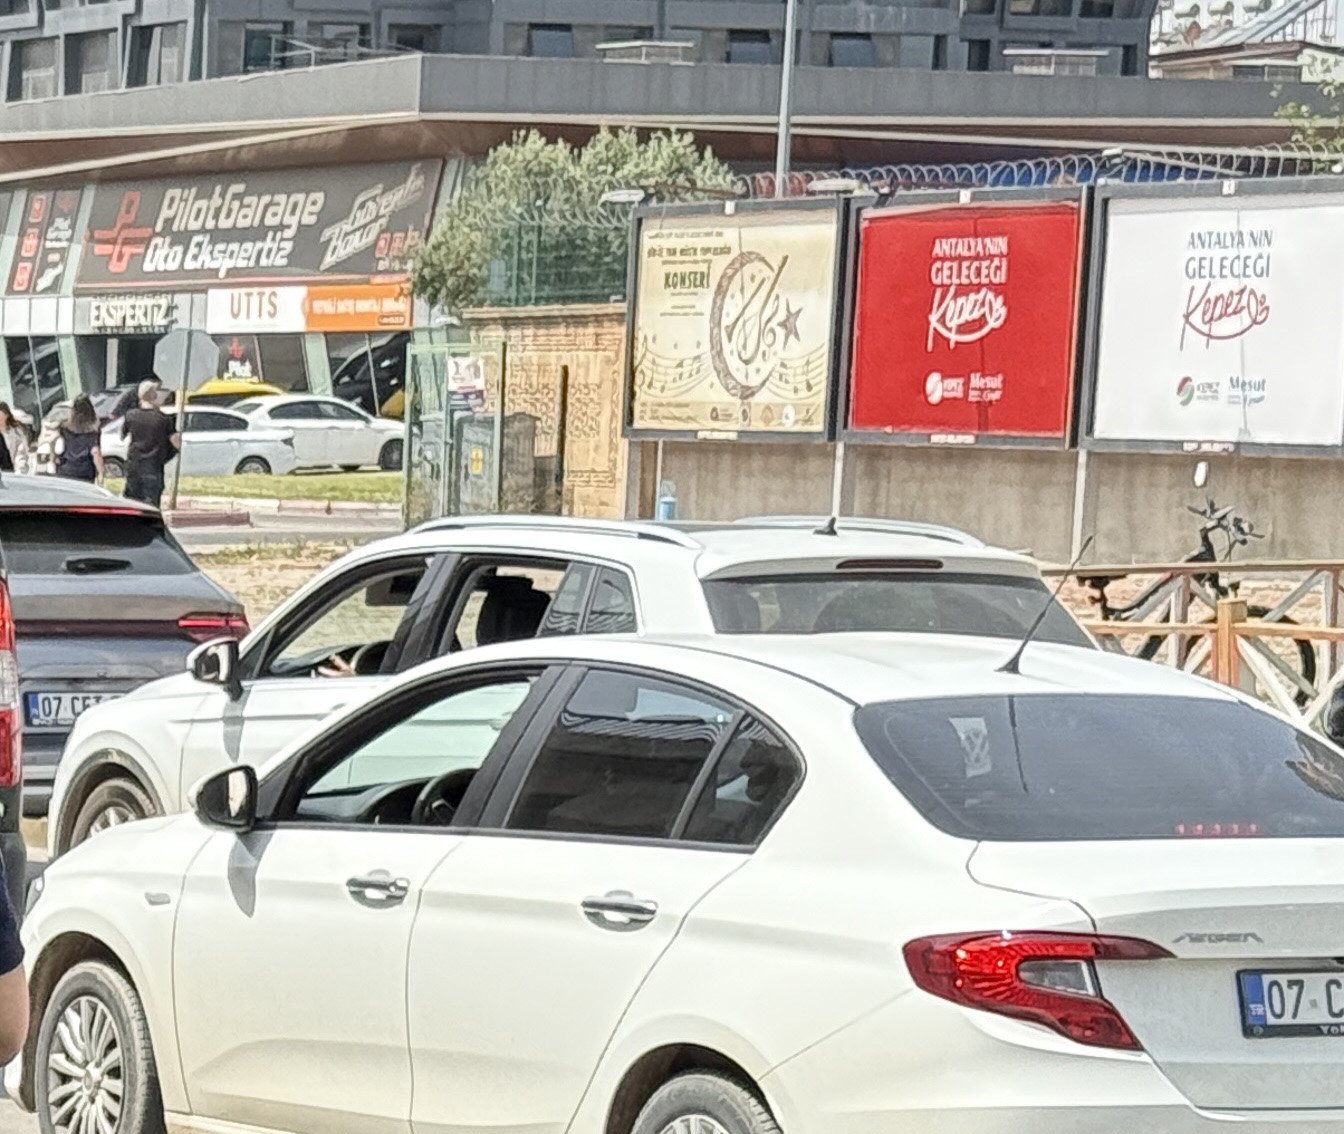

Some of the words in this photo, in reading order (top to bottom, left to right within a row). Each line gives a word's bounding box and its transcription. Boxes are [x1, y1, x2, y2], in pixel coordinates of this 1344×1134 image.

[155, 183, 325, 239] PilotGarage
[142, 236, 184, 272] Oto
[230, 290, 278, 320] UTTS
[41, 696, 63, 718] 07
[1267, 979, 1305, 1020] 07
